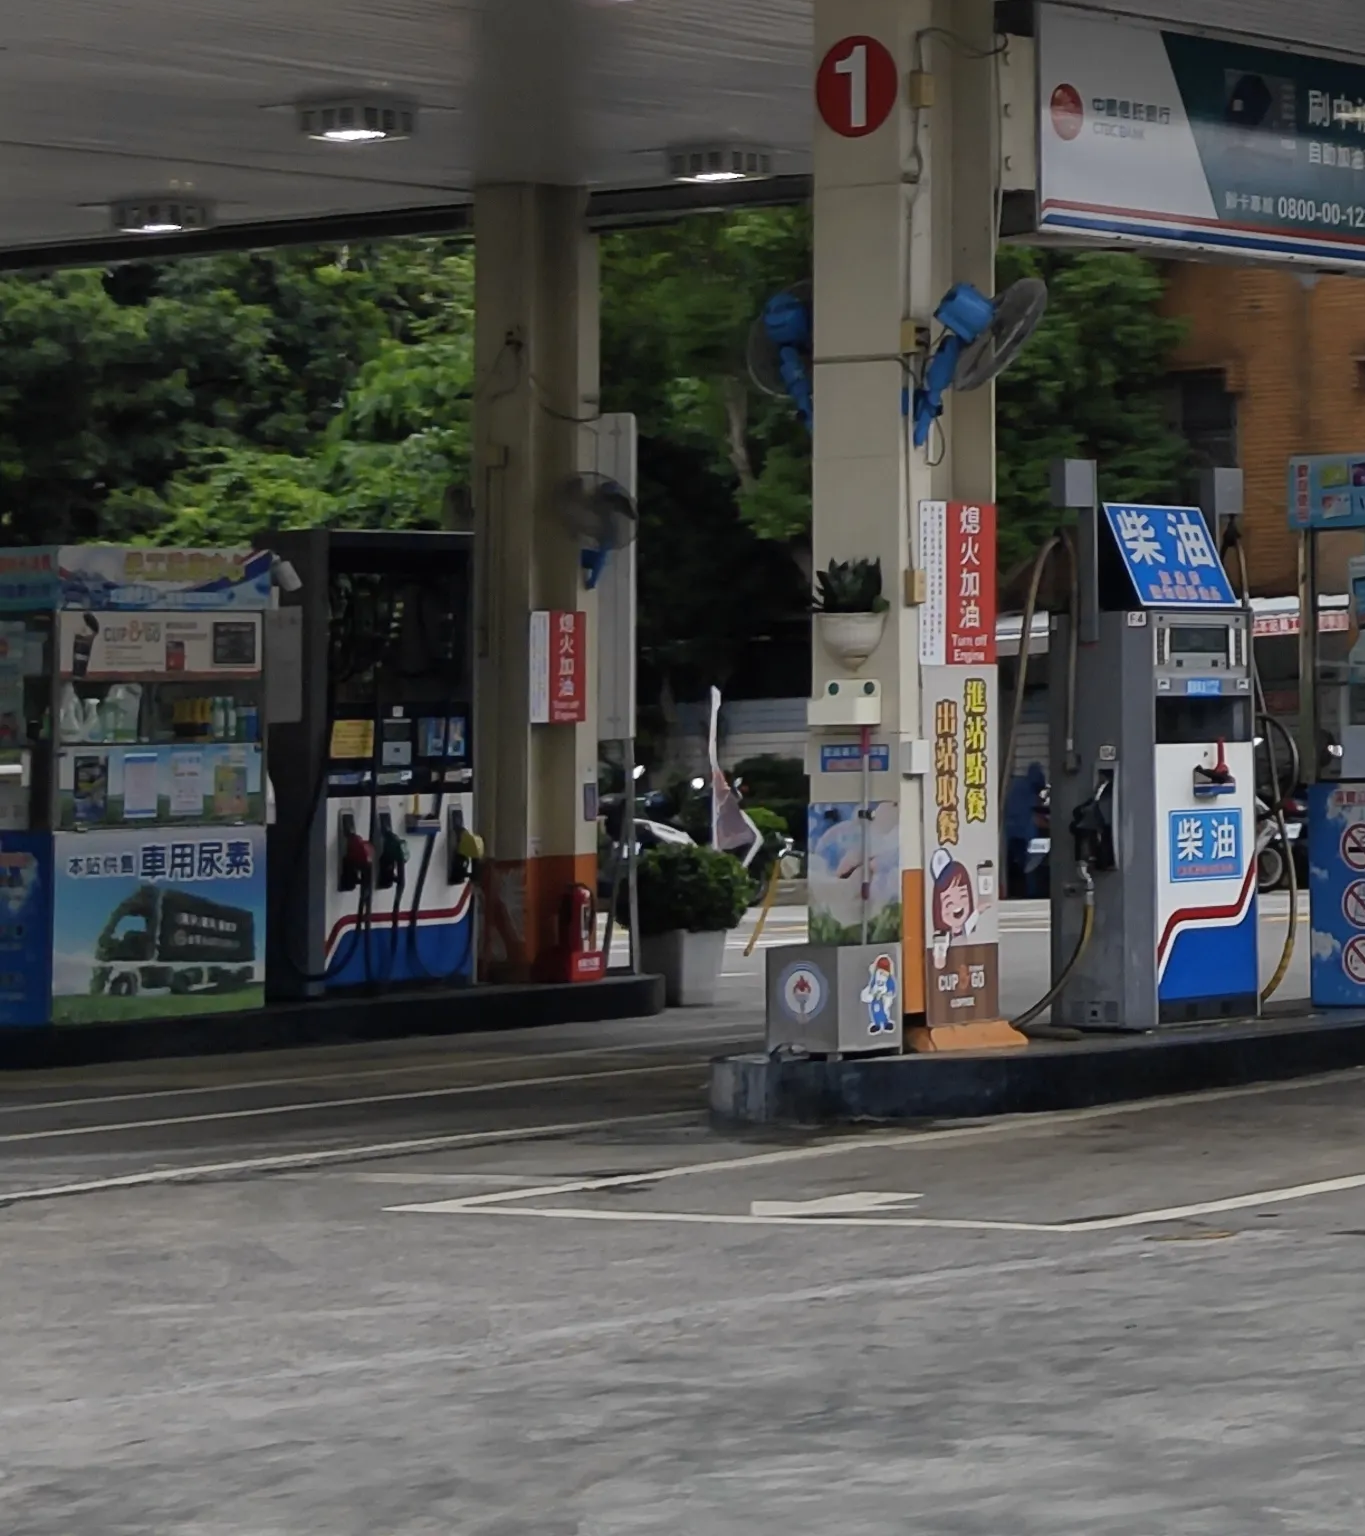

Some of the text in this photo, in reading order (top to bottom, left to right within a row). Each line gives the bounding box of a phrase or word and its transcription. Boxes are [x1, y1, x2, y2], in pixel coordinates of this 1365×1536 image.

[835, 44, 867, 127] 1
[959, 506, 980, 629] 熄火加油
[1116, 510, 1216, 568] 柴油
[963, 678, 988, 824] 進站點餐
[140, 840, 252, 878] 車用尿素
[1177, 817, 1236, 862] 柴油
